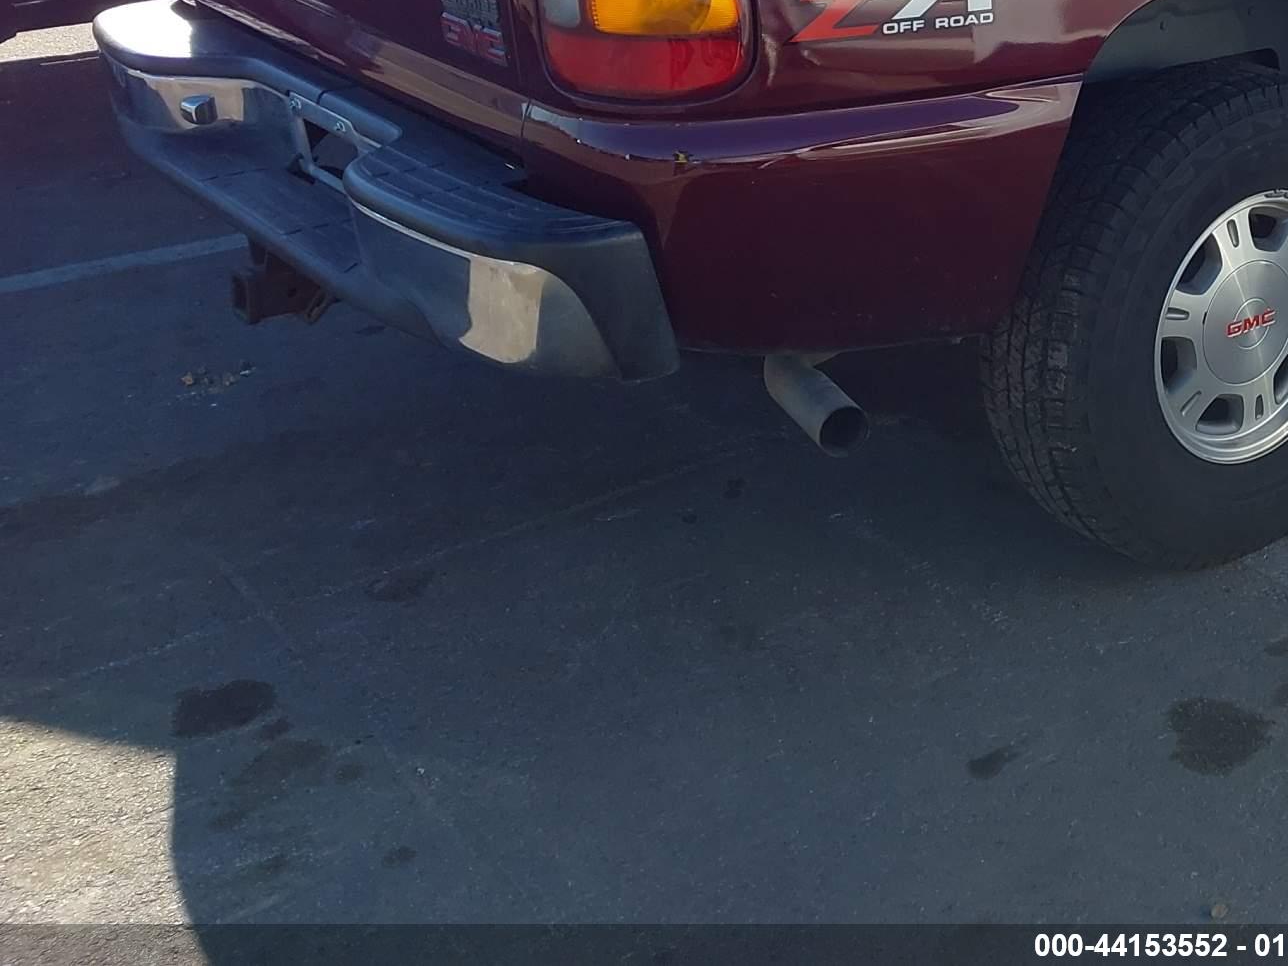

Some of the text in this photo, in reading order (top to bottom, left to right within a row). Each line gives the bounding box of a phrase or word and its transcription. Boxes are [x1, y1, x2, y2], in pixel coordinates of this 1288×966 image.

[882, 12, 994, 35] OFF ROAD
[1226, 308, 1276, 338] GMC
